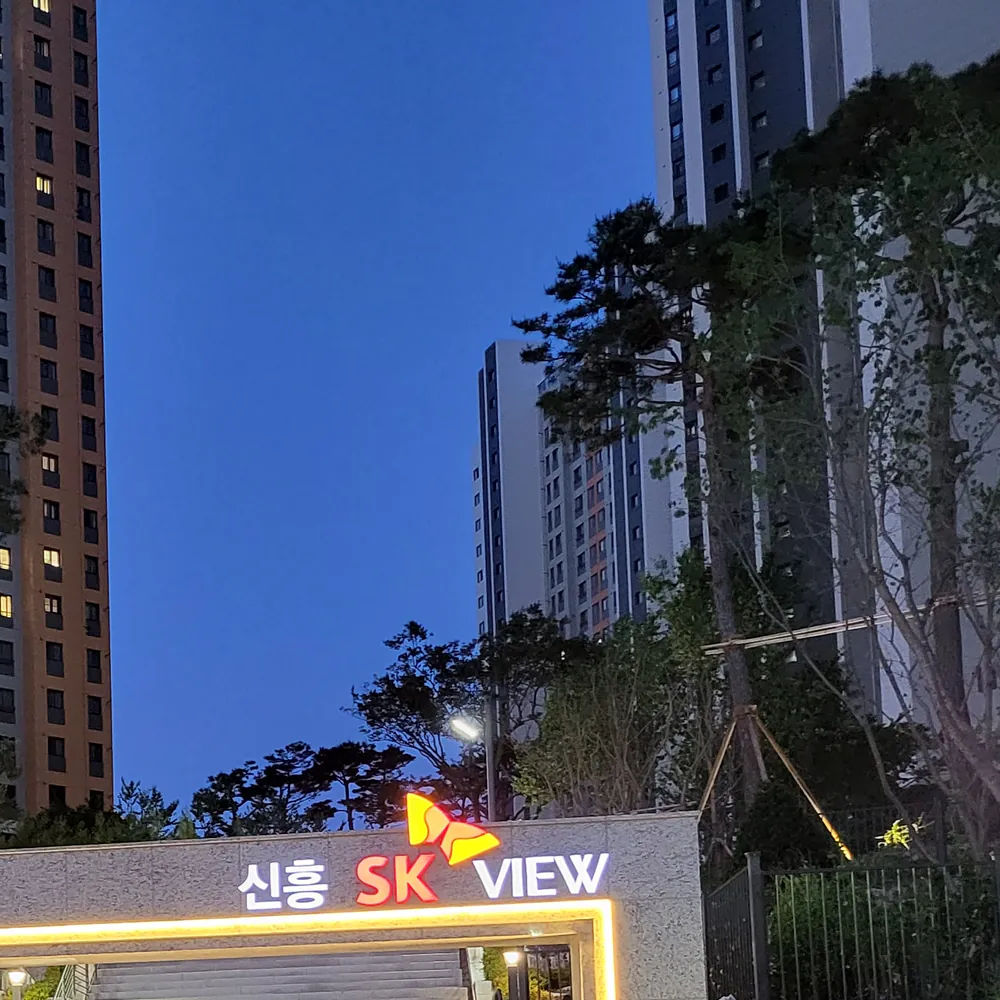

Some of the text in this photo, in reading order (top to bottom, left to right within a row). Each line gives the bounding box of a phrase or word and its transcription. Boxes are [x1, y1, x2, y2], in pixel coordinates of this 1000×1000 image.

[237, 853, 609, 911] 신흥 SK VIEW
